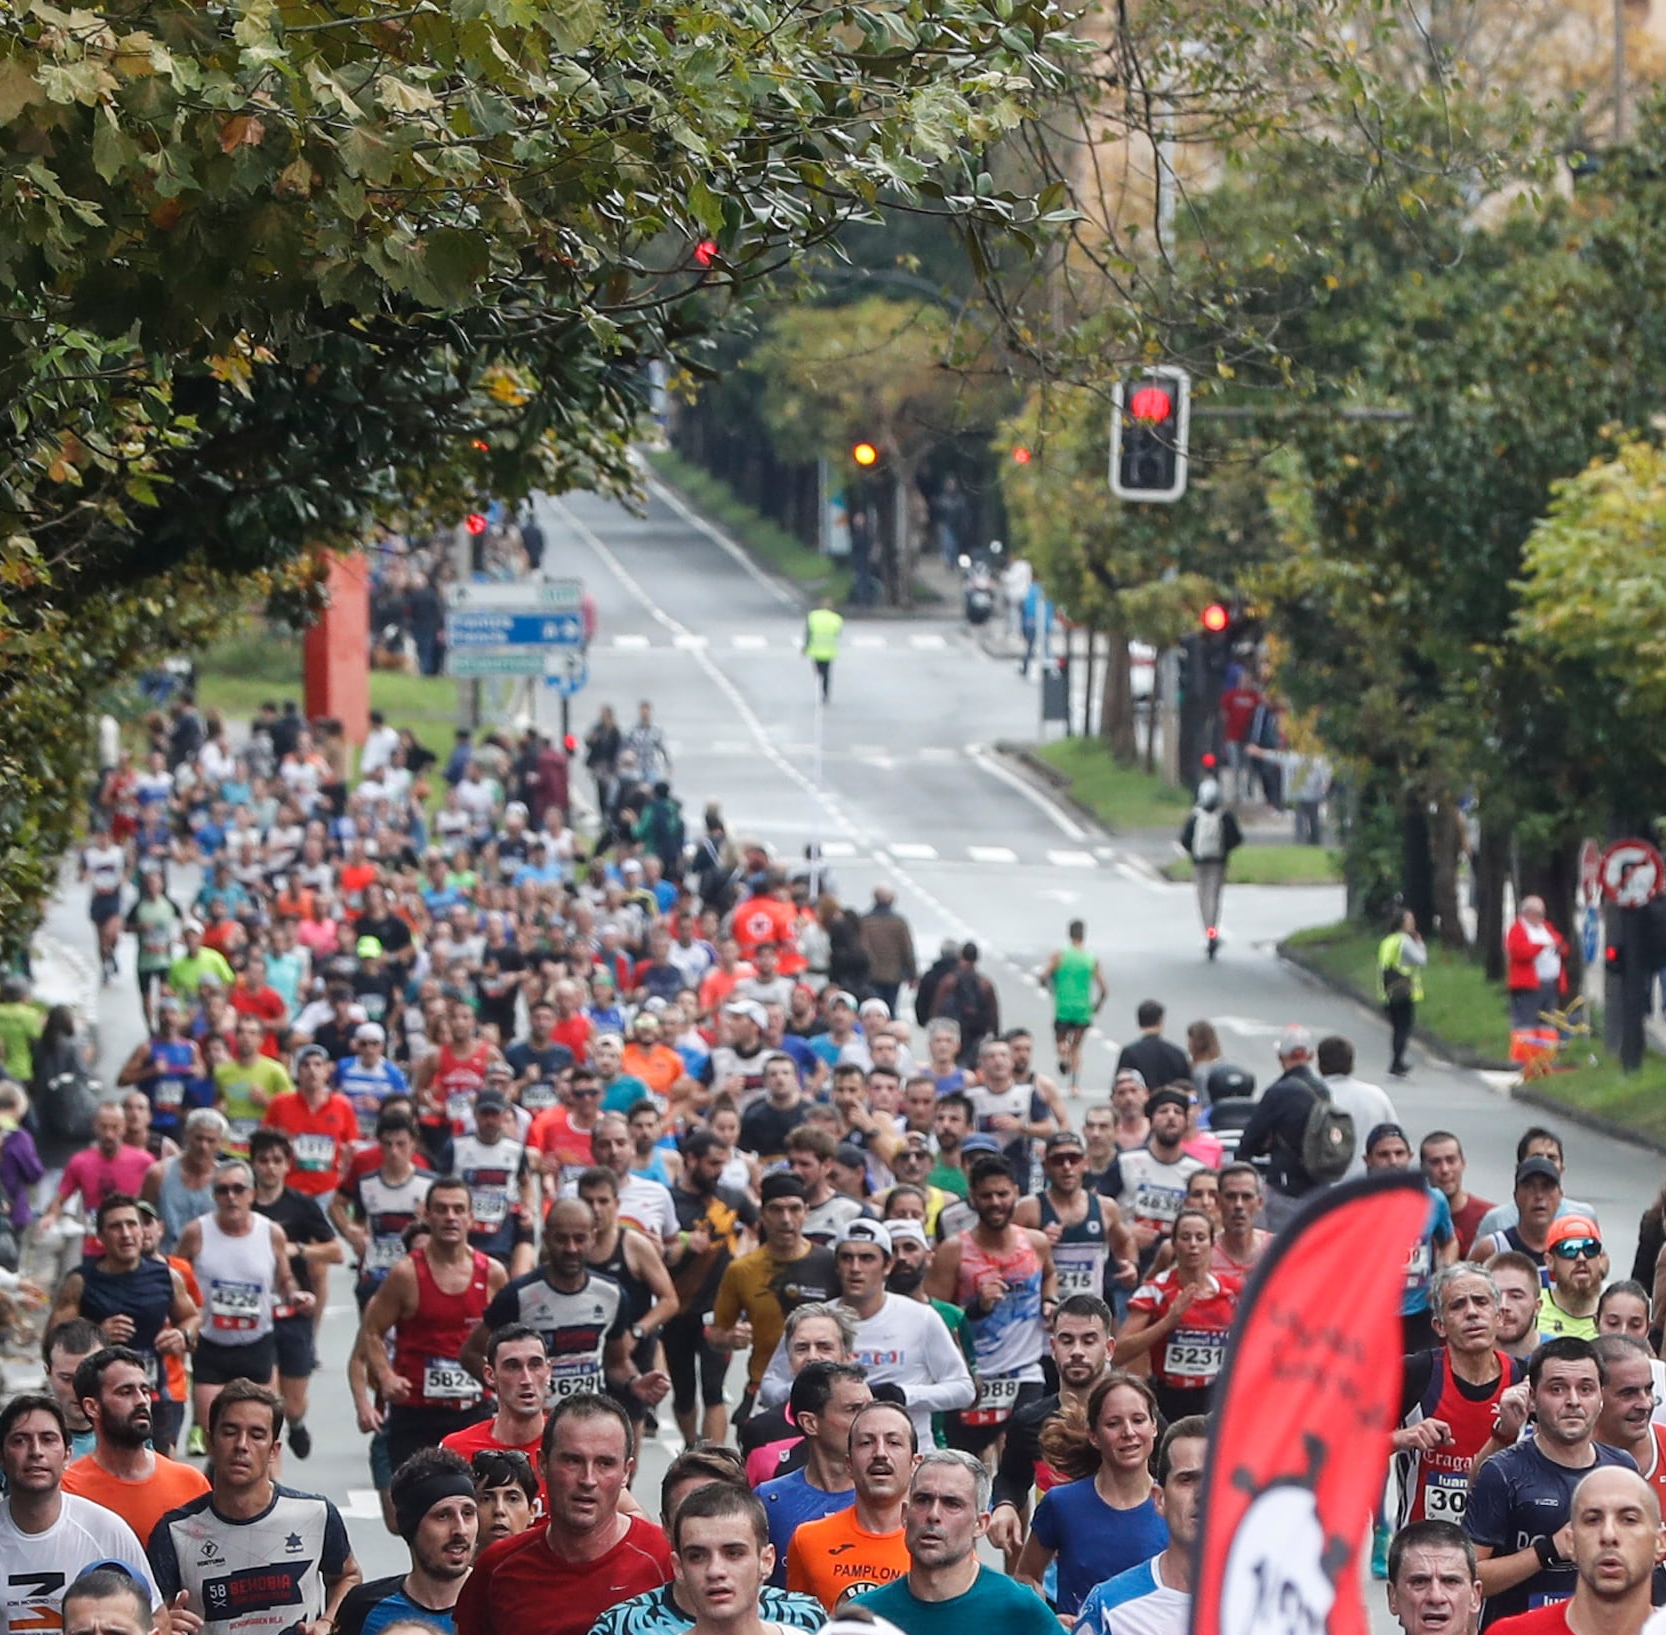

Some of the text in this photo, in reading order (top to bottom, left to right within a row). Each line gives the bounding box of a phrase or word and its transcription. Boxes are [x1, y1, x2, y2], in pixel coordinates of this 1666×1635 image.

[1170, 1347, 1223, 1364] 5231
[210, 1584, 227, 1598] 58
[229, 1573, 292, 1596] BEHOBIA
